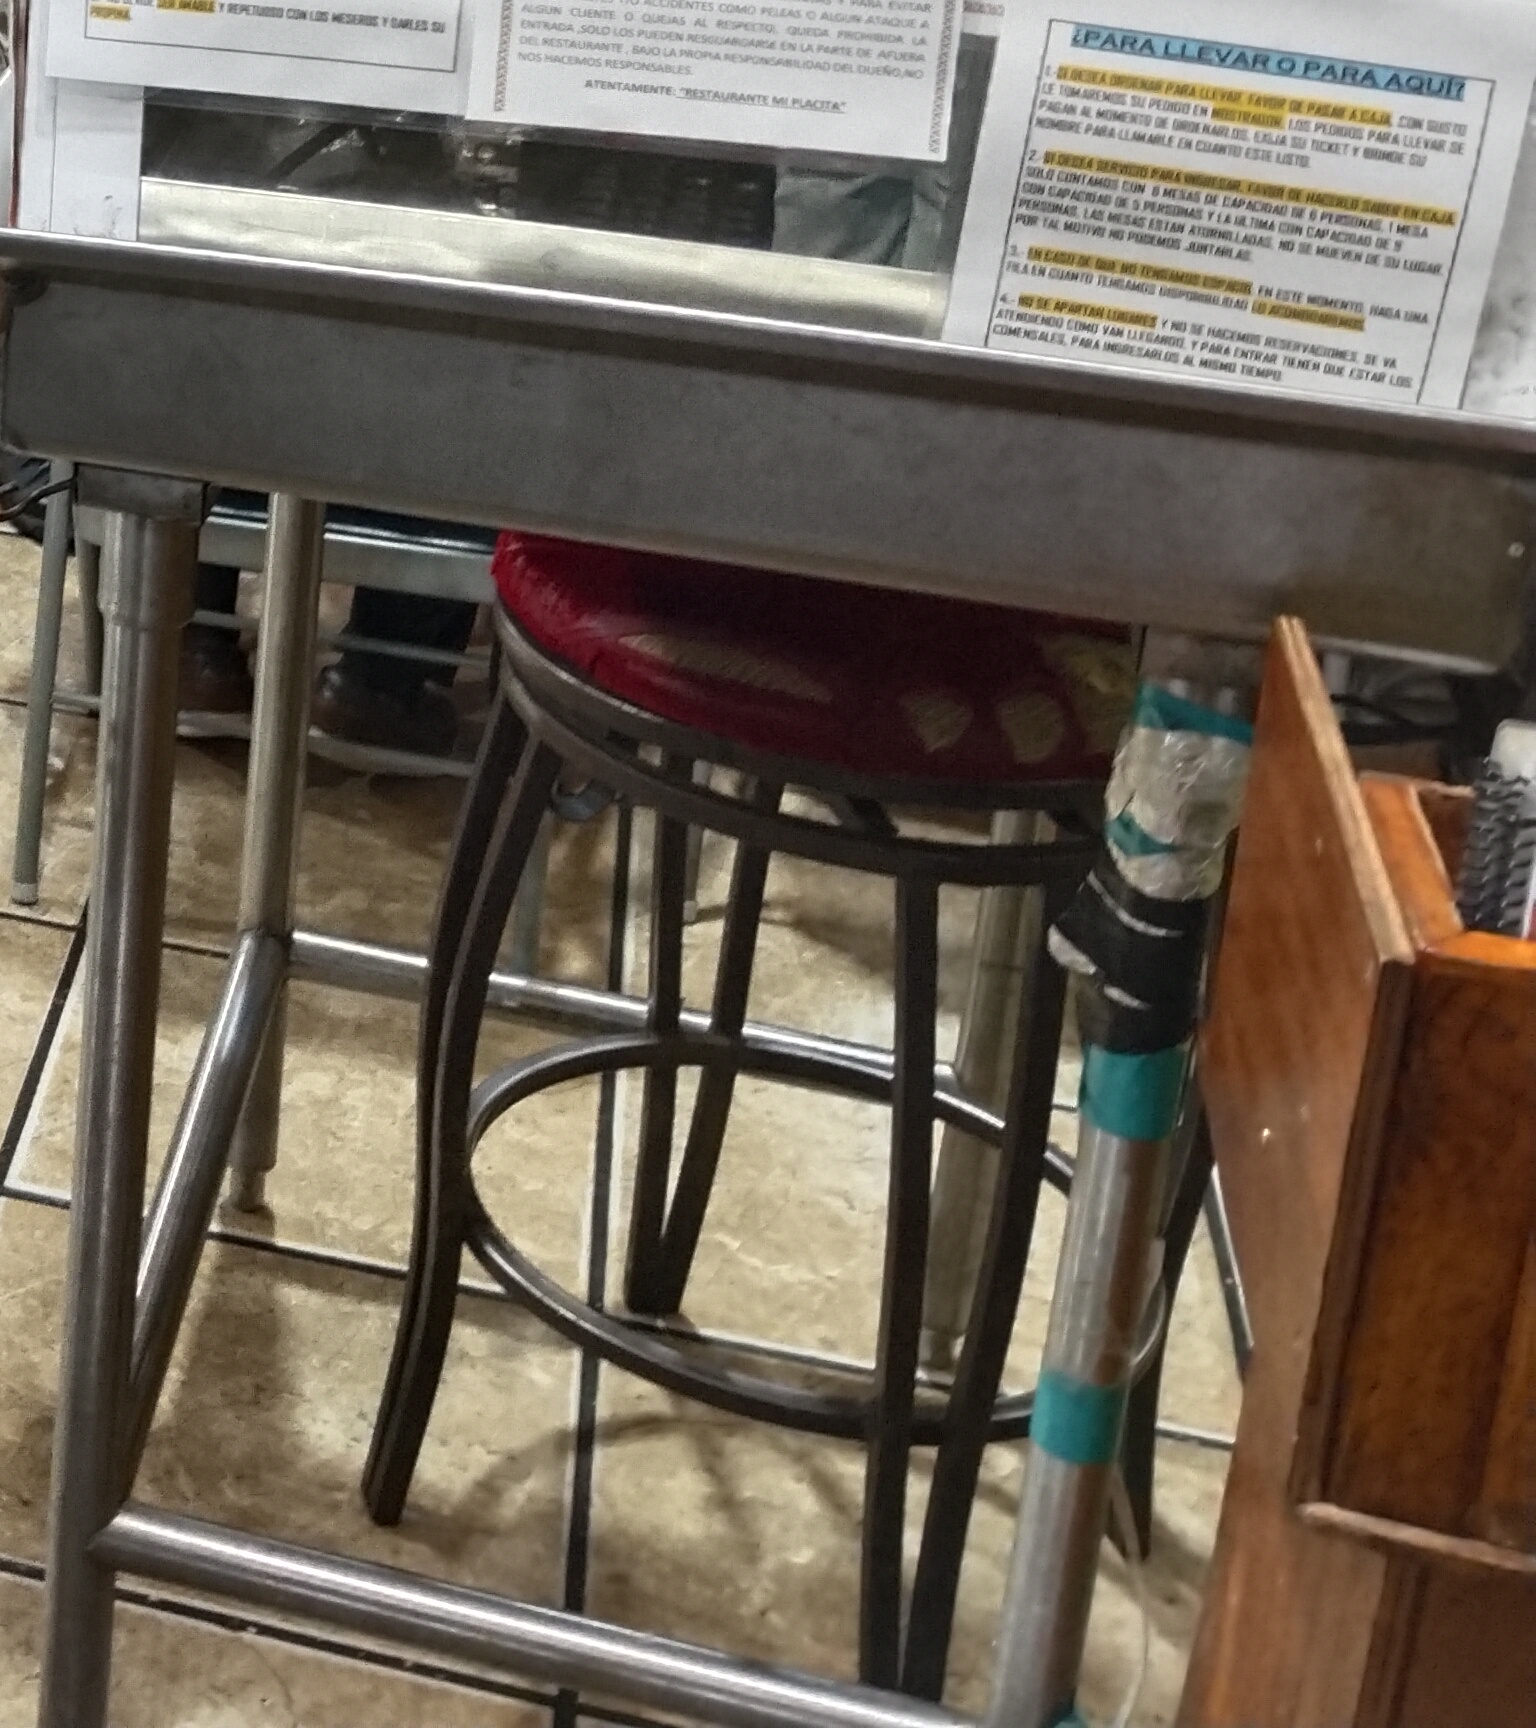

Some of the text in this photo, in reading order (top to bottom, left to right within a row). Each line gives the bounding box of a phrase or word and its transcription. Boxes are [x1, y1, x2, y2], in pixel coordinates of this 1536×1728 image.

[1072, 27, 1155, 56] ¿PARA
[1163, 40, 1269, 71] LLEVAR
[1275, 57, 1297, 73] O
[1303, 59, 1375, 88] PARA
